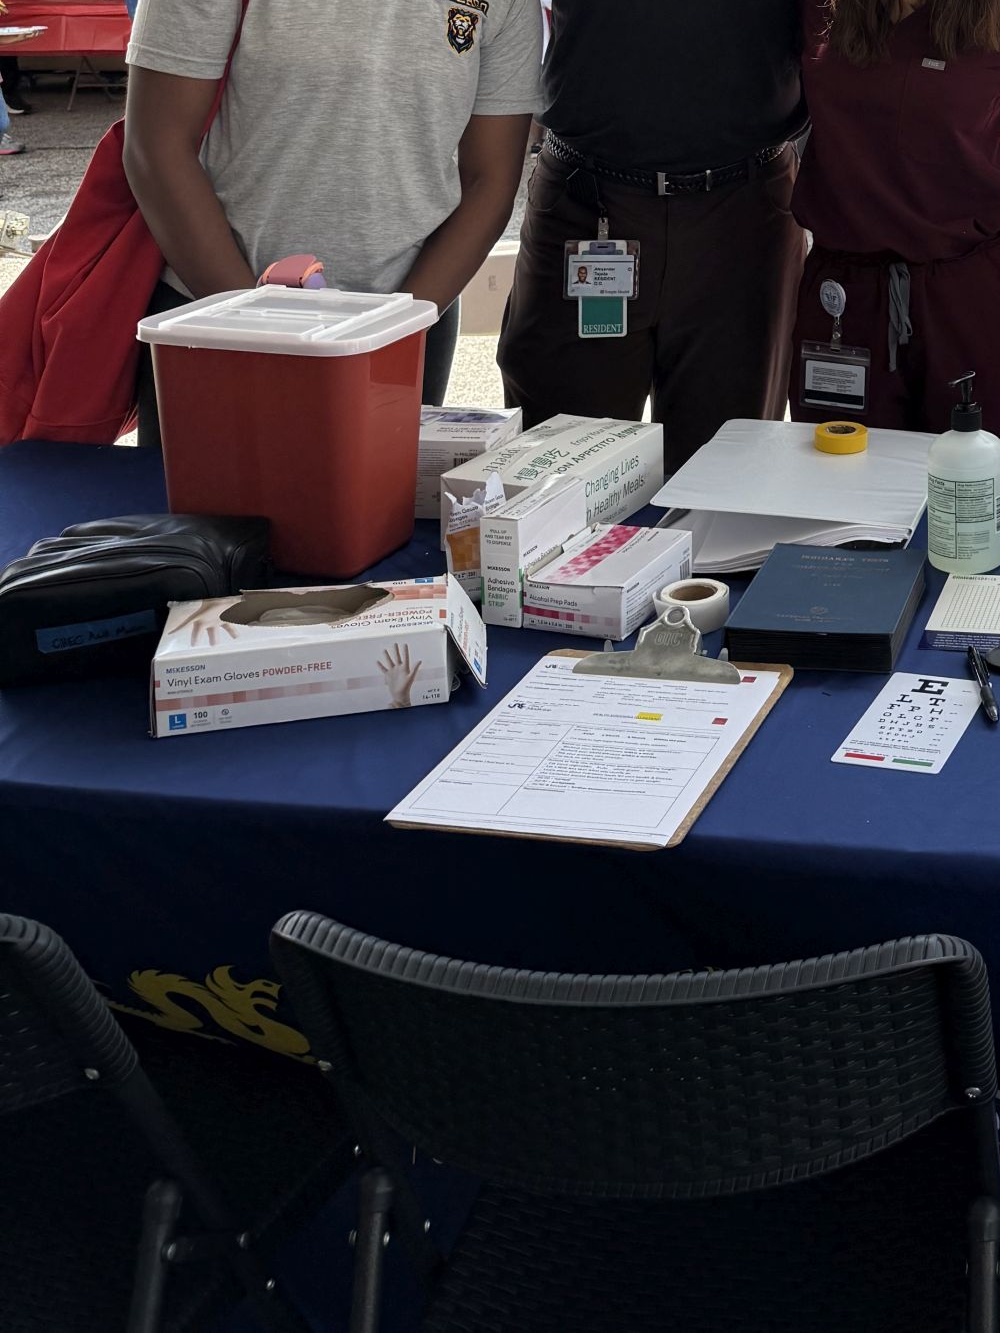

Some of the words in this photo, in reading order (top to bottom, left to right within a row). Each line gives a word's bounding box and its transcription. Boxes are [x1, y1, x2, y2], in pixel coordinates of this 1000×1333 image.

[583, 324, 622, 334] RESIDENT
[573, 437, 616, 463] APPETITO
[514, 448, 570, 481] 慢慢吃
[584, 465, 619, 498] Changing
[620, 454, 640, 476] Lives
[593, 490, 622, 517] Healthy
[488, 578, 515, 586] Adhesive
[488, 585, 517, 594] Bandages
[529, 593, 550, 603] Alcohol
[550, 598, 563, 606] Prep
[167, 676, 192, 688] Vinyl
[194, 673, 222, 685] Exam
[224, 670, 260, 682] Gloves
[262, 661, 332, 676] POWDER-FREE
[910, 678, 949, 695] E
[193, 710, 208, 719] 100
